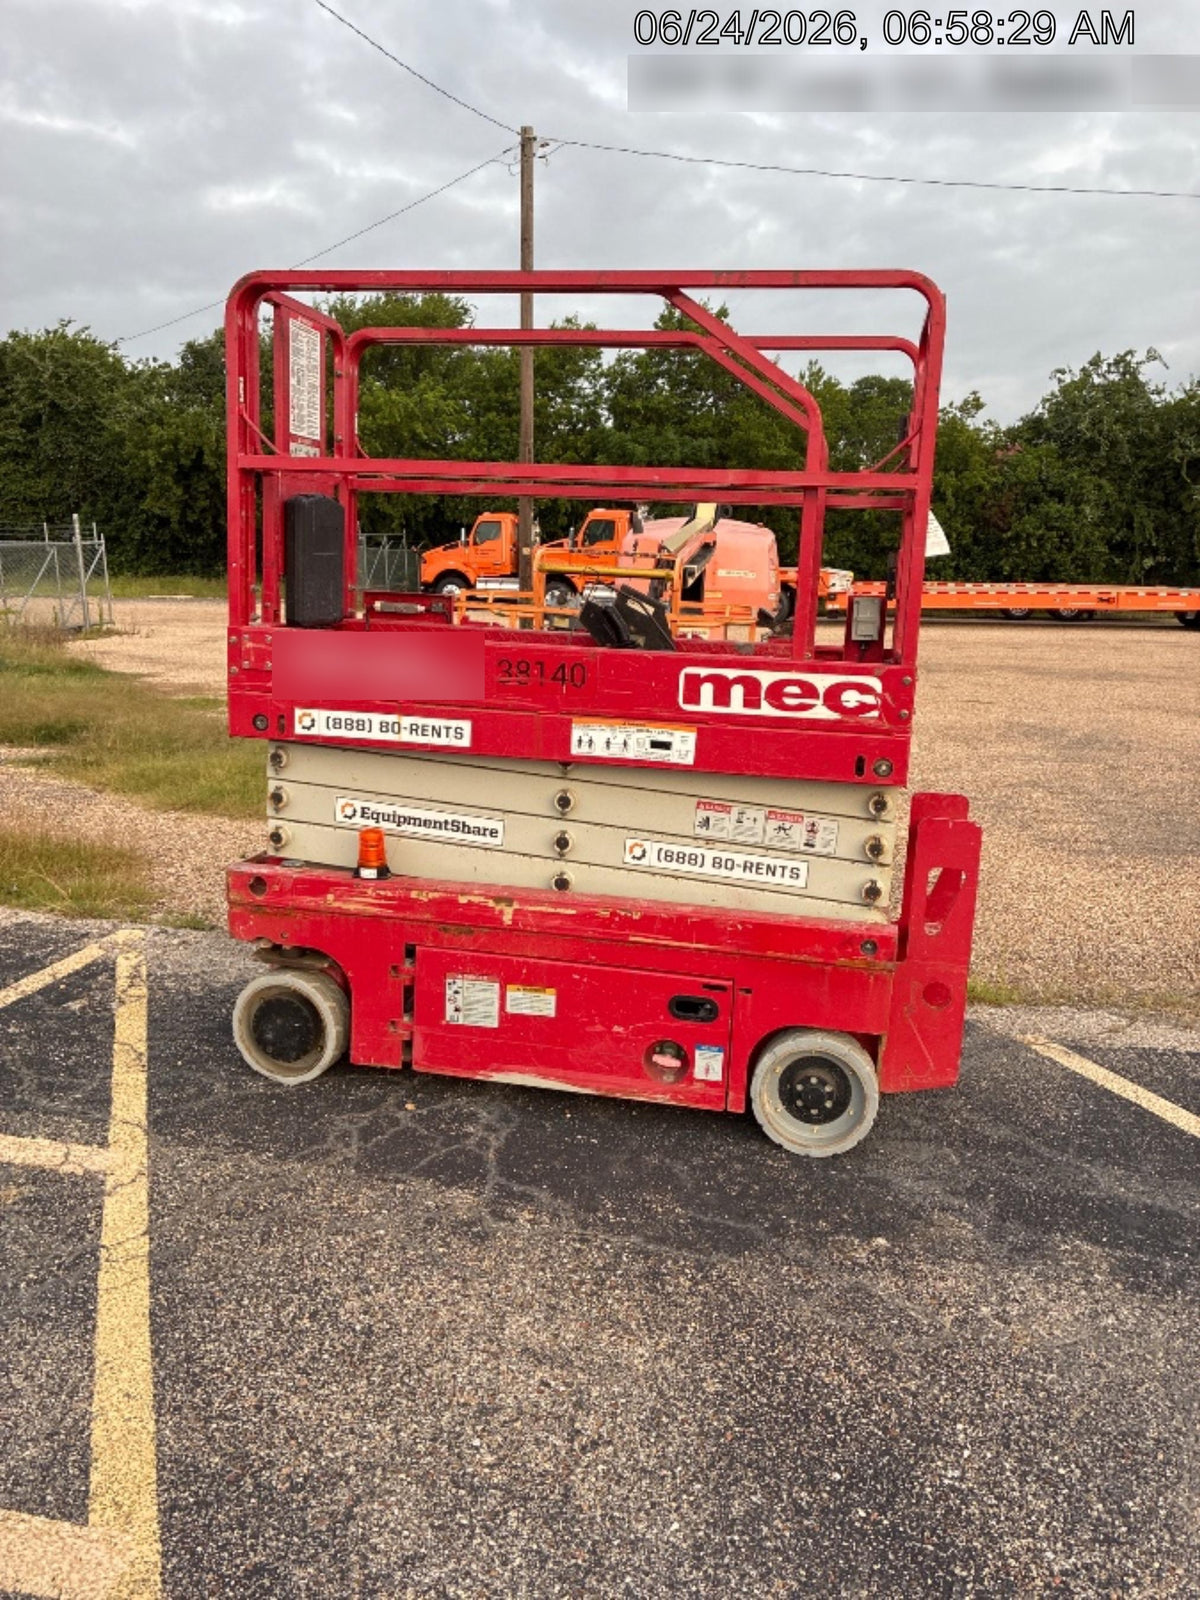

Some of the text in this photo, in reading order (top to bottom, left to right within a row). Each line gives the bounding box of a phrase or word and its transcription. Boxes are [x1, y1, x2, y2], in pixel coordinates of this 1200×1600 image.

[497, 658, 586, 688] 38140
[683, 671, 882, 719] mec
[325, 716, 373, 733] (888)
[360, 807, 500, 839] EquipmentShare
[656, 846, 705, 868] (888)
